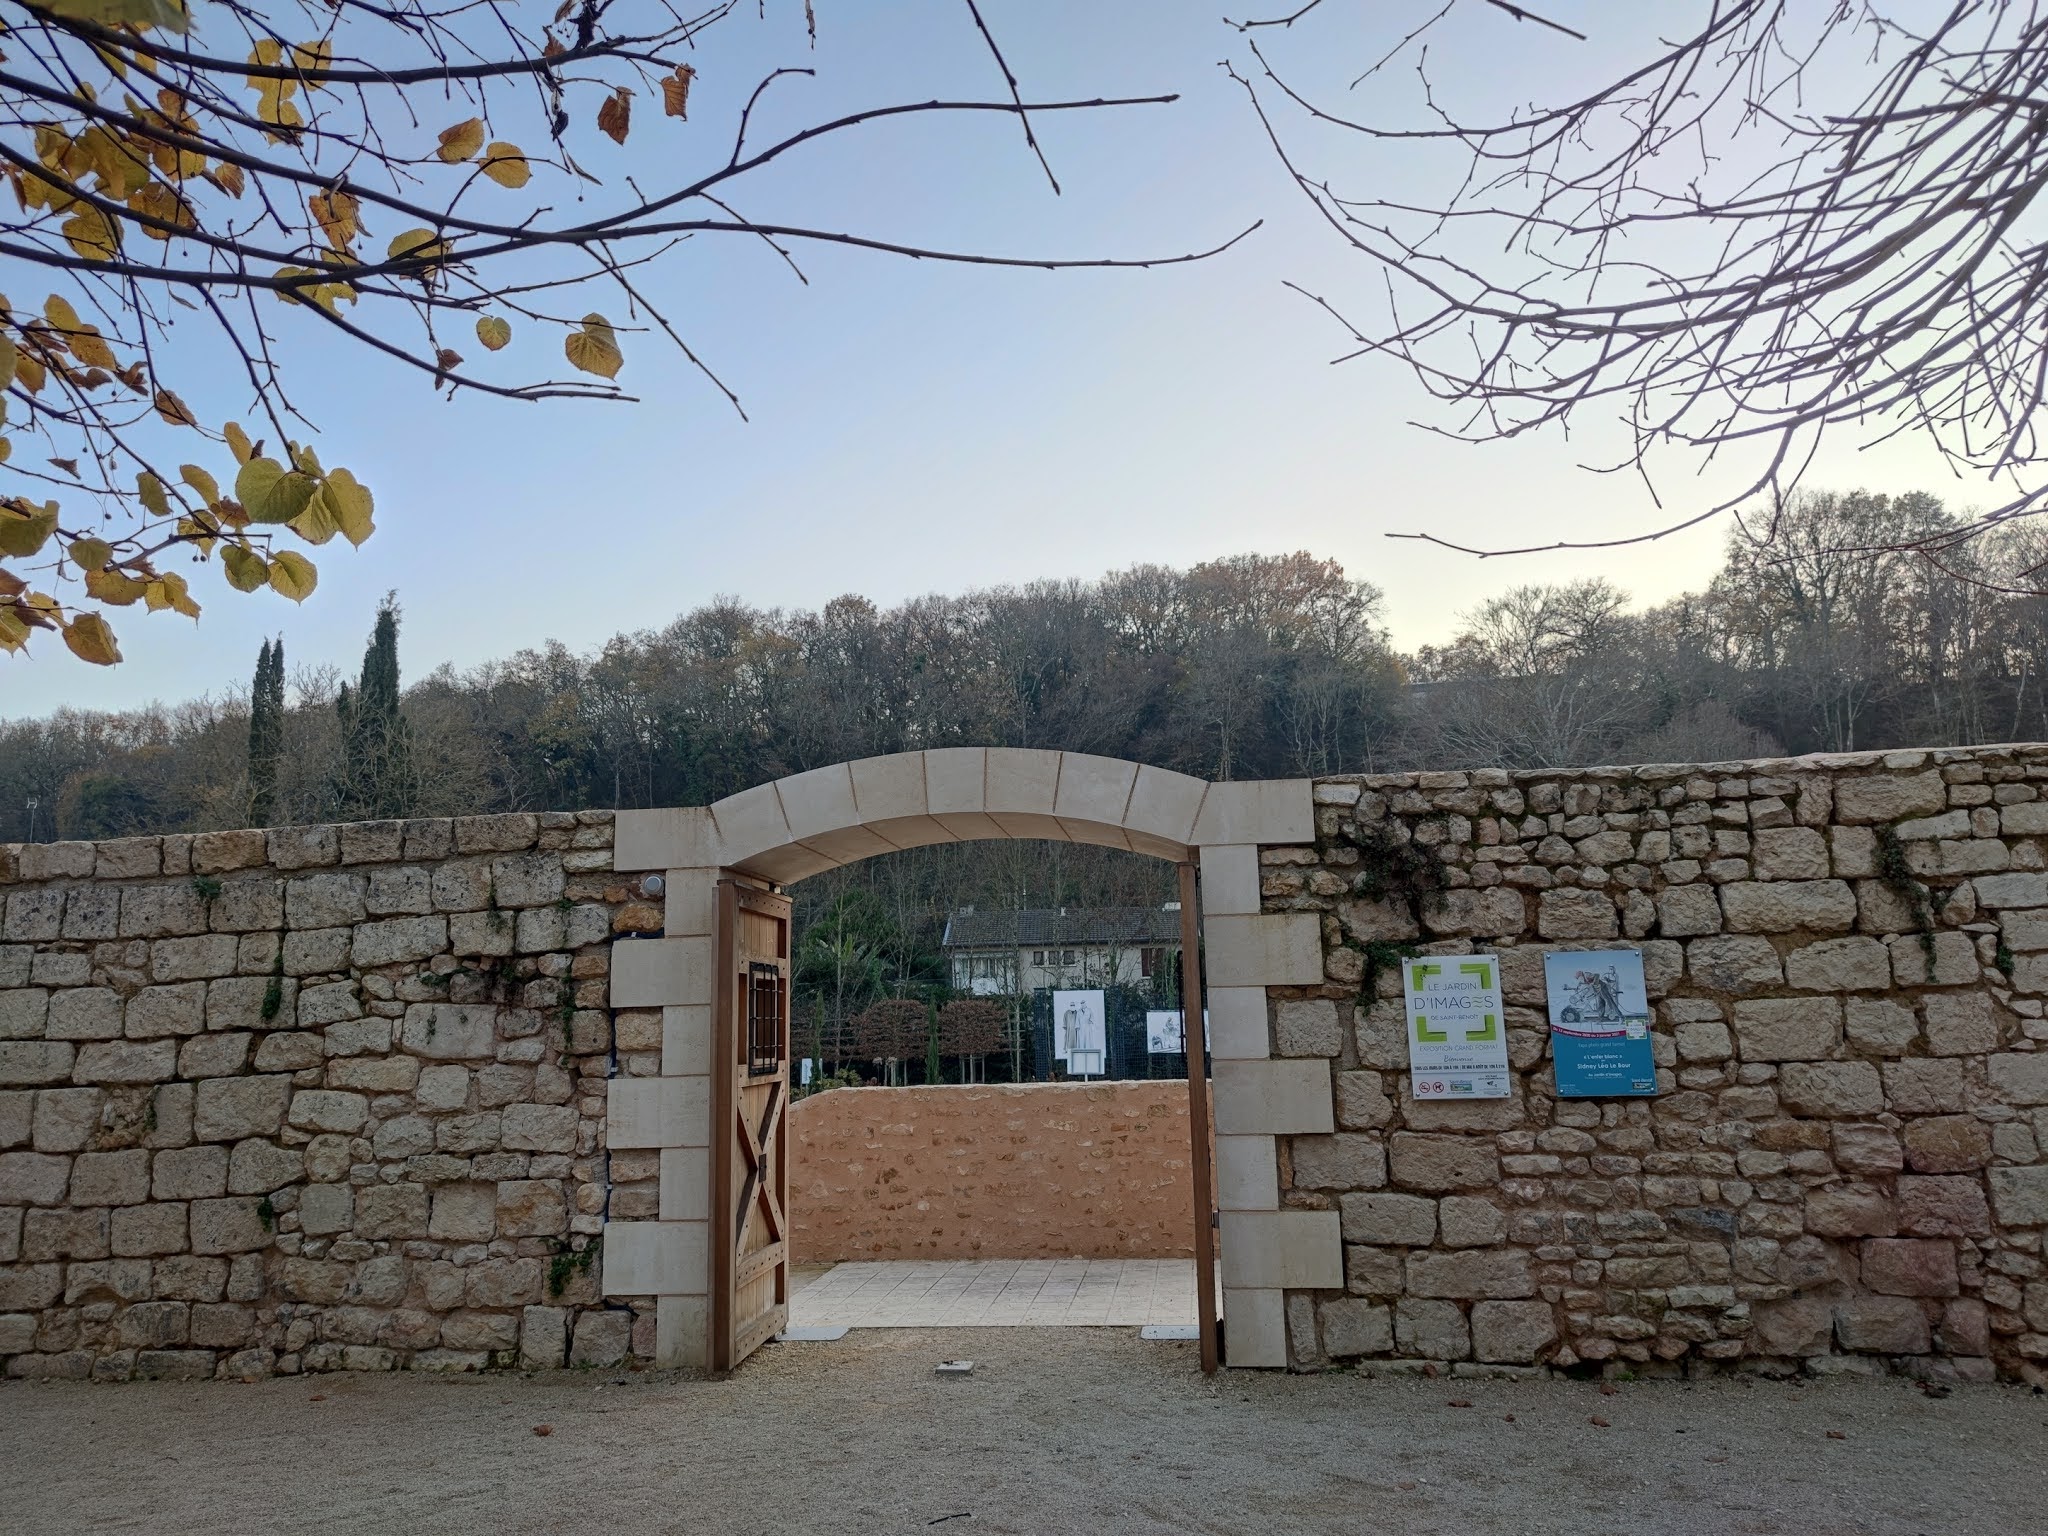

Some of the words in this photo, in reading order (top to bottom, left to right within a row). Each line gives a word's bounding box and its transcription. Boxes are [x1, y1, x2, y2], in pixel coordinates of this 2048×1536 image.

[1428, 983, 1439, 991] LE
[1442, 982, 1477, 990] JARDIN
[1414, 996, 1494, 1010] D'IMAGES
